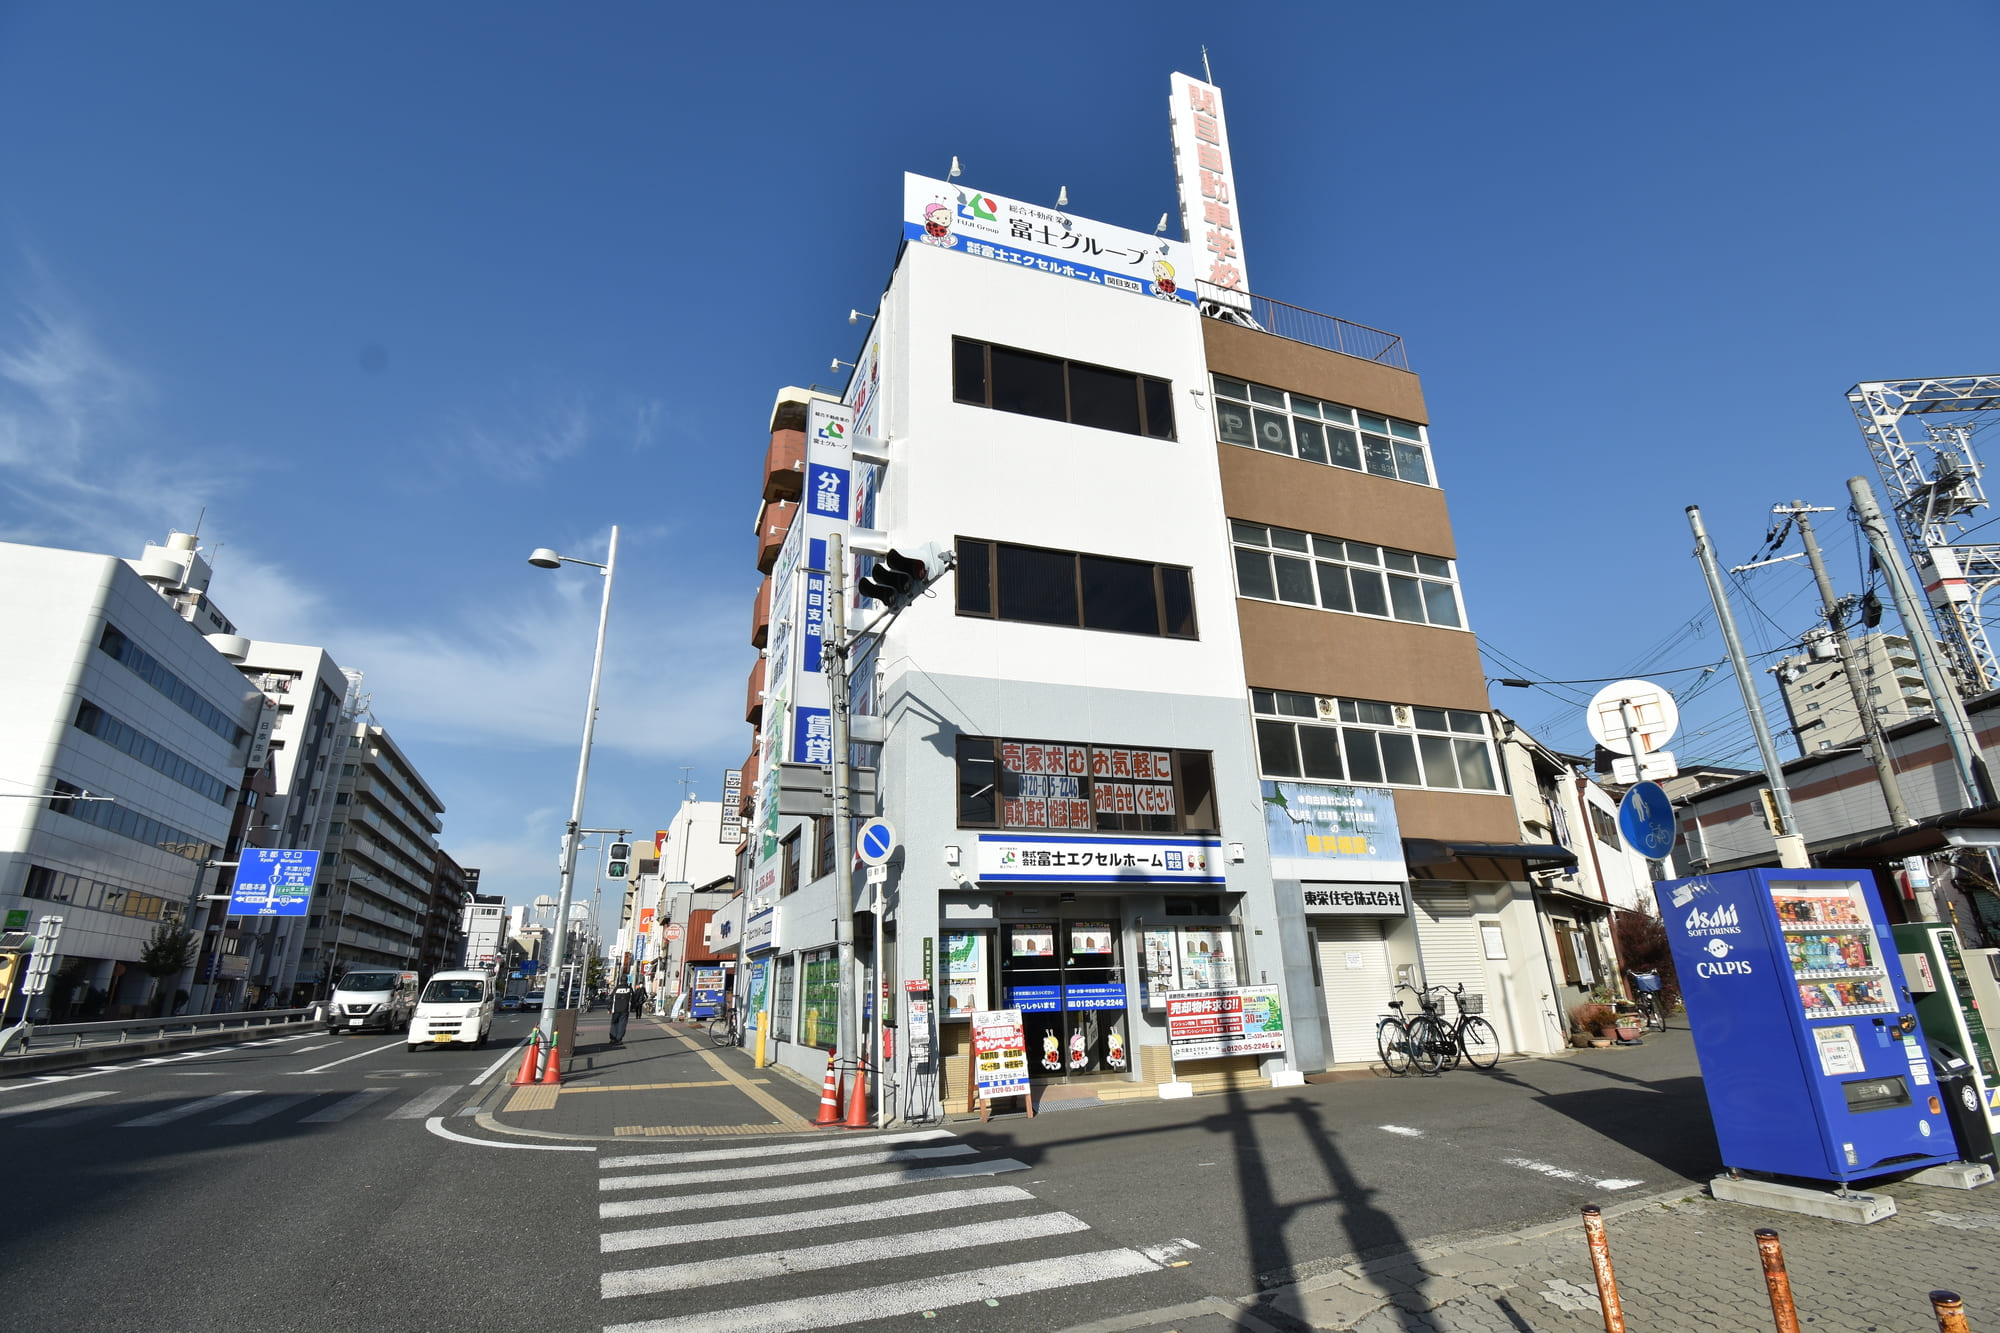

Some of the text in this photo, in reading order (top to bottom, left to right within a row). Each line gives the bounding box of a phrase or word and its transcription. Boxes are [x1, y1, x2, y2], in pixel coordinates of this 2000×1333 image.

[1188, 84, 1243, 296] 関目自動車学校
[1009, 204, 1073, 229] 総合不動産業の
[957, 218, 1000, 235] FUJI Group
[1009, 217, 1149, 265] 富士グループ
[1107, 276, 1140, 291] 関目支店
[815, 411, 849, 423] 総合不動産業の
[813, 438, 848, 450] 富士グループ
[817, 471, 841, 513] 分譲
[807, 578, 823, 637] 関目支店
[805, 714, 832, 763] 賃貸
[1003, 743, 1087, 774] 売家求む
[1093, 751, 1170, 778] お気軽に
[1018, 775, 1078, 797] 0120-05-2246
[1095, 785, 1174, 813] お問合せください
[1004, 799, 1089, 828] 買取査定相談無料
[1331, 824, 1339, 833] の
[258, 850, 303, 859] 京都 守口
[1304, 890, 1402, 906] 東栄住宅株式会社
[1685, 903, 1739, 930] Asahi
[1688, 926, 1742, 937] SOFT DRINKS
[1696, 961, 1753, 979] CALPIS
[1009, 1002, 1056, 1010] いらっしゃいませ
[1076, 998, 1124, 1008] 0120-05-2246
[1170, 998, 1240, 1015] 売却物件求む!!
[1245, 1014, 1256, 1024] 30
[1227, 1043, 1270, 1052] 0120-05-2246
[991, 1085, 1026, 1095] 0120-05-2246
